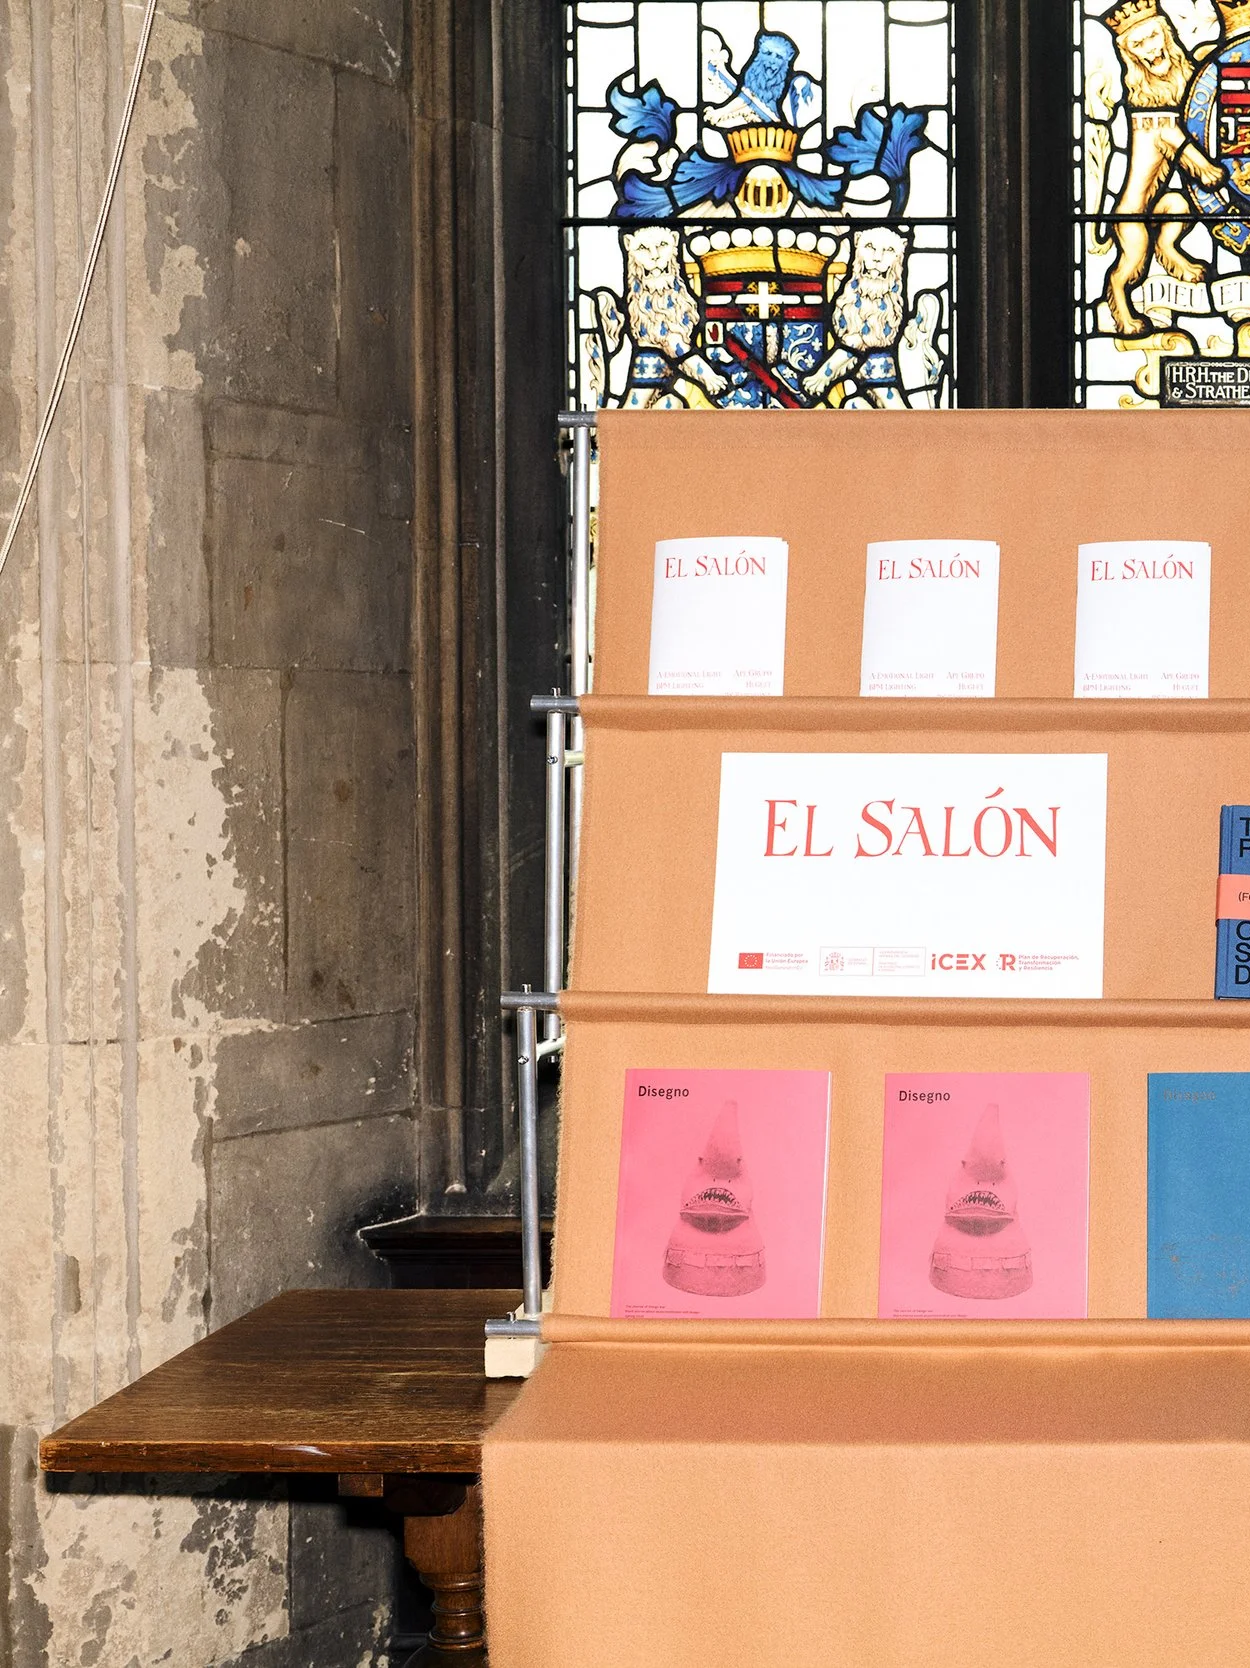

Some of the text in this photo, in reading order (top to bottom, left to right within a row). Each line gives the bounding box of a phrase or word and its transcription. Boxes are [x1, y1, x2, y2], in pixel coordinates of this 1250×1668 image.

[1149, 282, 1204, 309] DIEU
[1220, 282, 1250, 305] ET
[1172, 388, 1183, 399] &
[666, 550, 765, 578] EL SALÓN
[879, 553, 979, 580] EL SALÓN
[1092, 554, 1193, 581] EL SALÓN
[764, 787, 1060, 859] EL SALÓN
[639, 1086, 689, 1100] Disegno
[899, 1090, 950, 1104] Disegno
